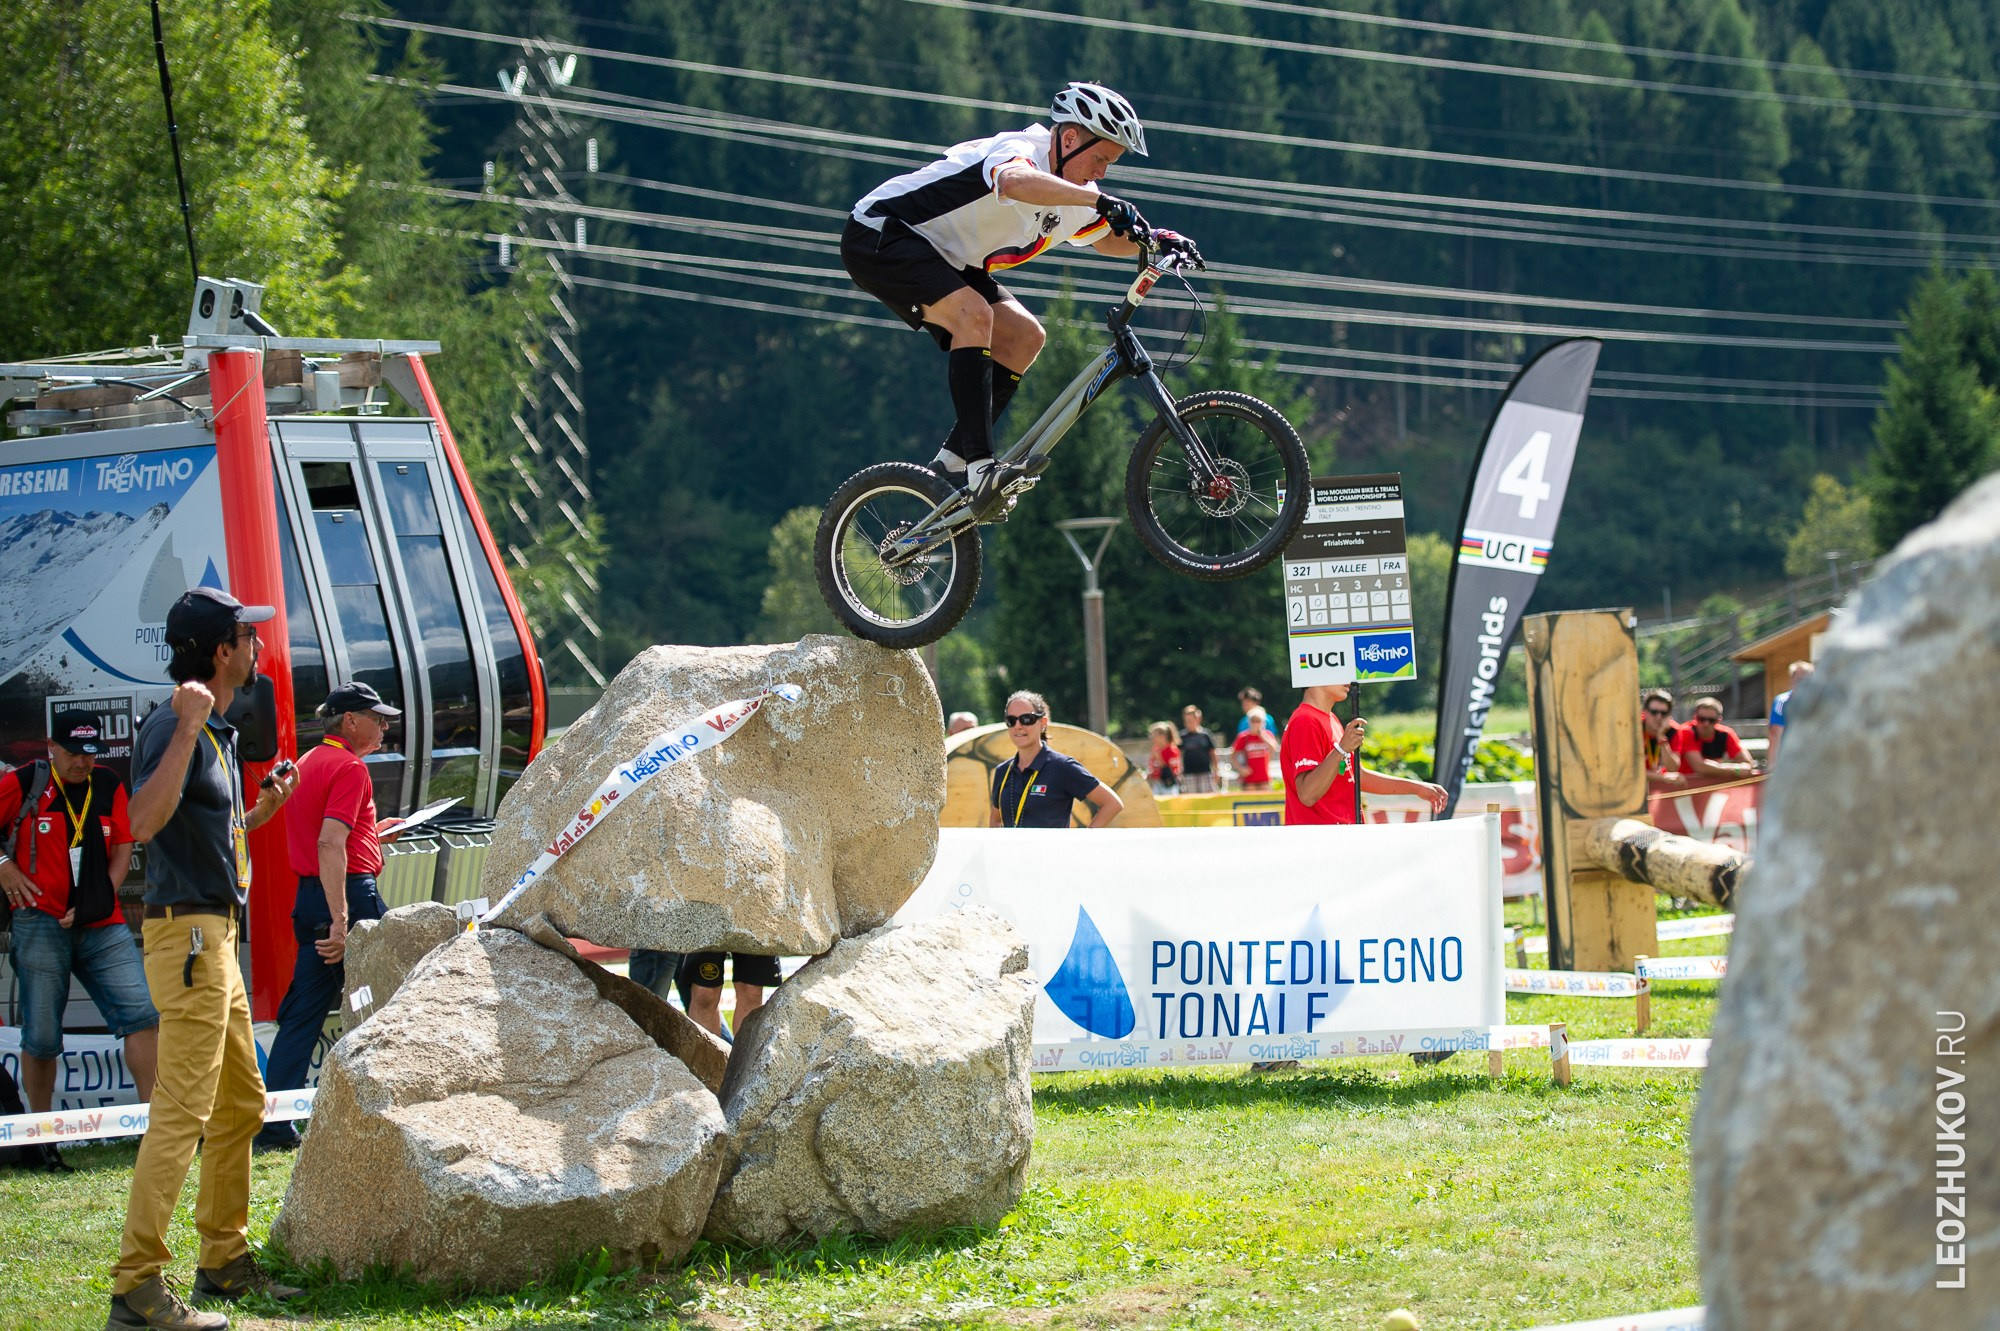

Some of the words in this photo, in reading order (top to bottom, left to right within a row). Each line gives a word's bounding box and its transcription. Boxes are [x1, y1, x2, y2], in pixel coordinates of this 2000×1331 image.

[1178, 402, 1206, 416] ONTY
[1185, 443, 1202, 468] ECHO
[0, 468, 69, 497] RESENA
[96, 457, 193, 493] TRENTINO
[1498, 430, 1552, 520] 4
[1316, 495, 1338, 503] WORLD
[1339, 493, 1387, 501] CHAMPIONSHIPS
[1329, 487, 1360, 495] MOUNTAIN
[1323, 538, 1365, 547] #TrialsWorlds
[1486, 539, 1525, 563] UCI
[1292, 566, 1311, 577] 321
[1331, 563, 1367, 574] VALLEE
[1383, 561, 1401, 570] FRA
[1290, 585, 1303, 594] HC
[1314, 582, 1320, 593] 1
[1333, 581, 1340, 592] 2
[1354, 580, 1361, 590] 3
[1374, 578, 1382, 589] 4
[1395, 577, 1403, 588] 5
[1292, 602, 1304, 622] 2
[1308, 651, 1345, 669] UCI
[1358, 645, 1409, 662] TRENTINO
[54, 702, 68, 714] UCI
[69, 700, 109, 712] MOUNTAIN
[111, 699, 128, 710] BIKE
[705, 713, 740, 733] Val
[620, 734, 699, 783] TRENTINO
[578, 789, 620, 827] Sole
[574, 822, 586, 838] di
[545, 831, 575, 857] Val
[1151, 936, 1463, 986] PONTEDILEGNO
